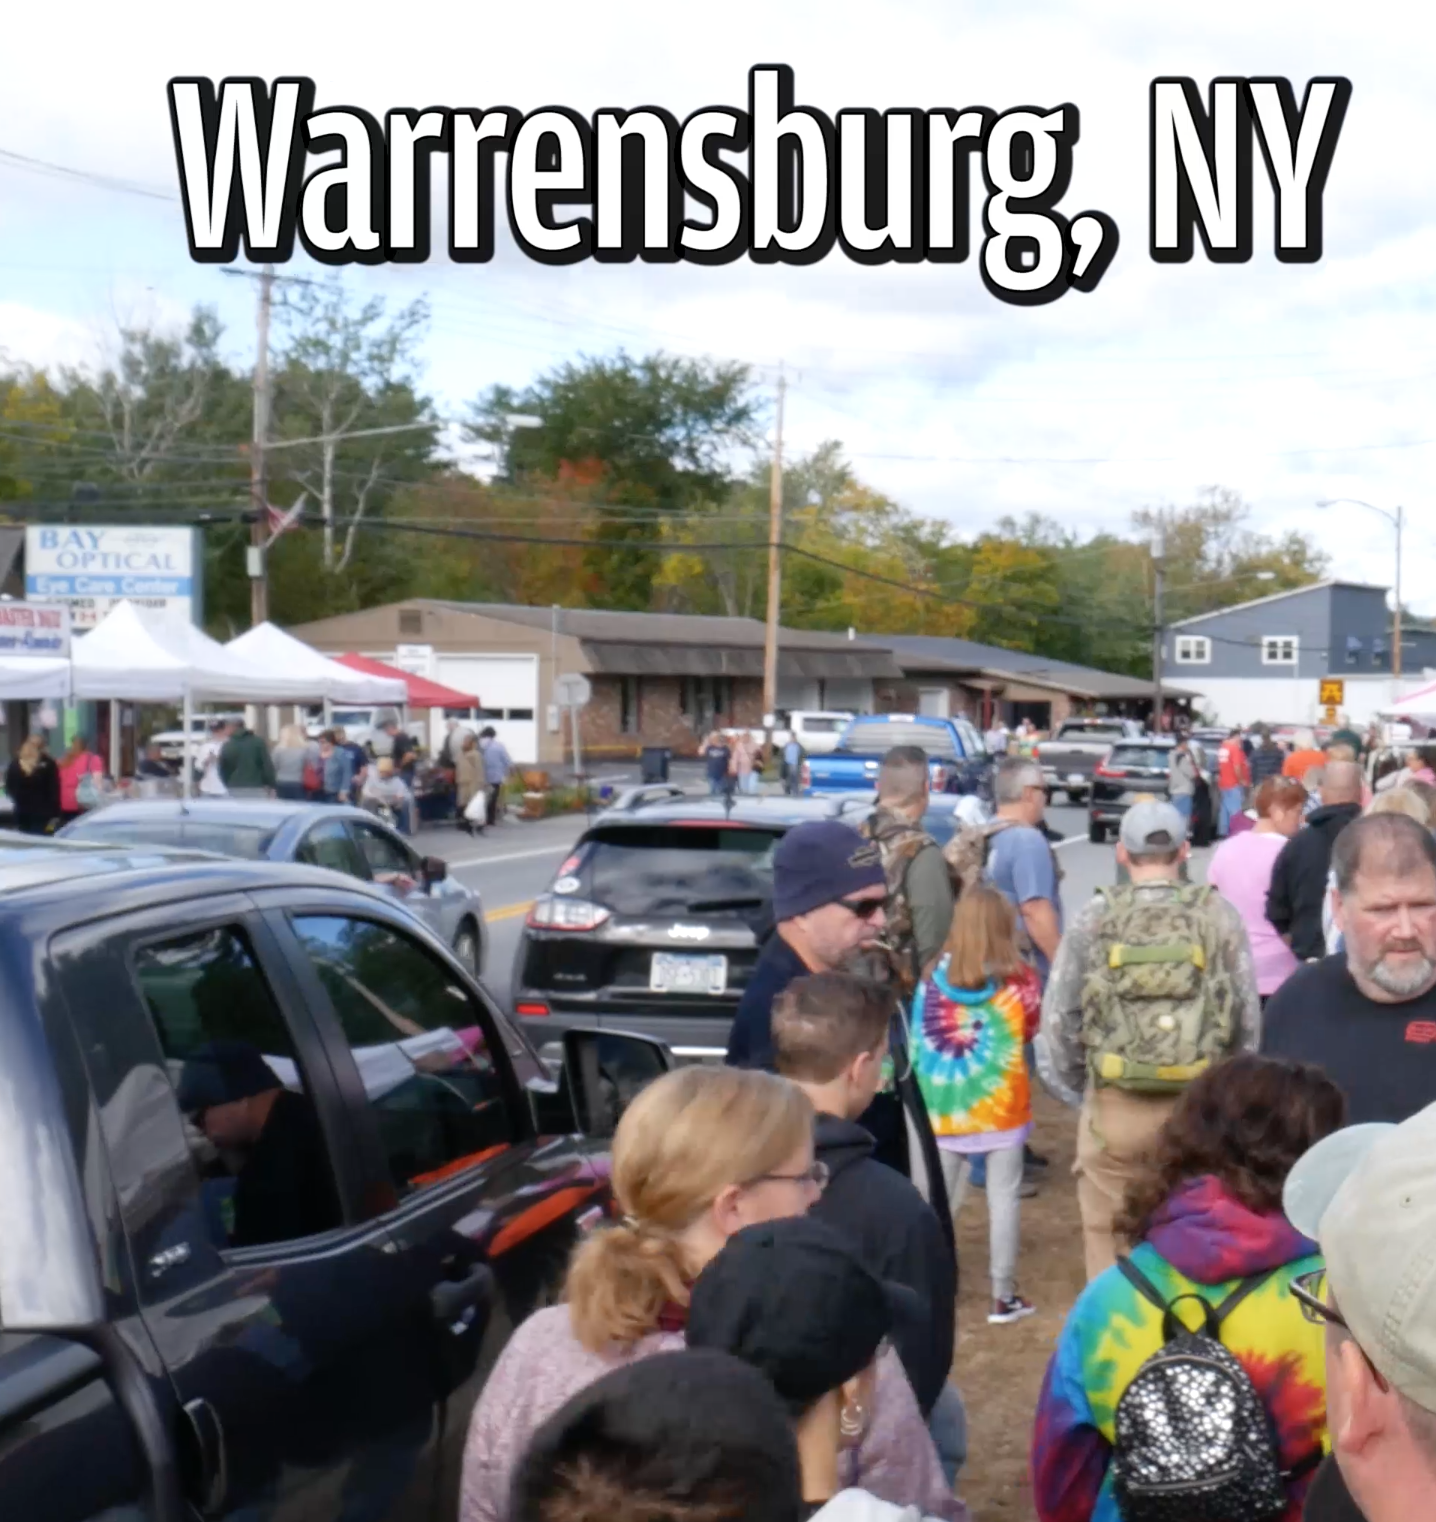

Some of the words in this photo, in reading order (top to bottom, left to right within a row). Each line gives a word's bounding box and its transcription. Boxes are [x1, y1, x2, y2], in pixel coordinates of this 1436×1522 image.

[39, 529, 104, 550] BAY
[56, 551, 176, 570] OPTICAL
[36, 577, 70, 595] Eye
[74, 577, 115, 594] Care
[121, 577, 179, 594] Center
[667, 923, 710, 941] Jeep
